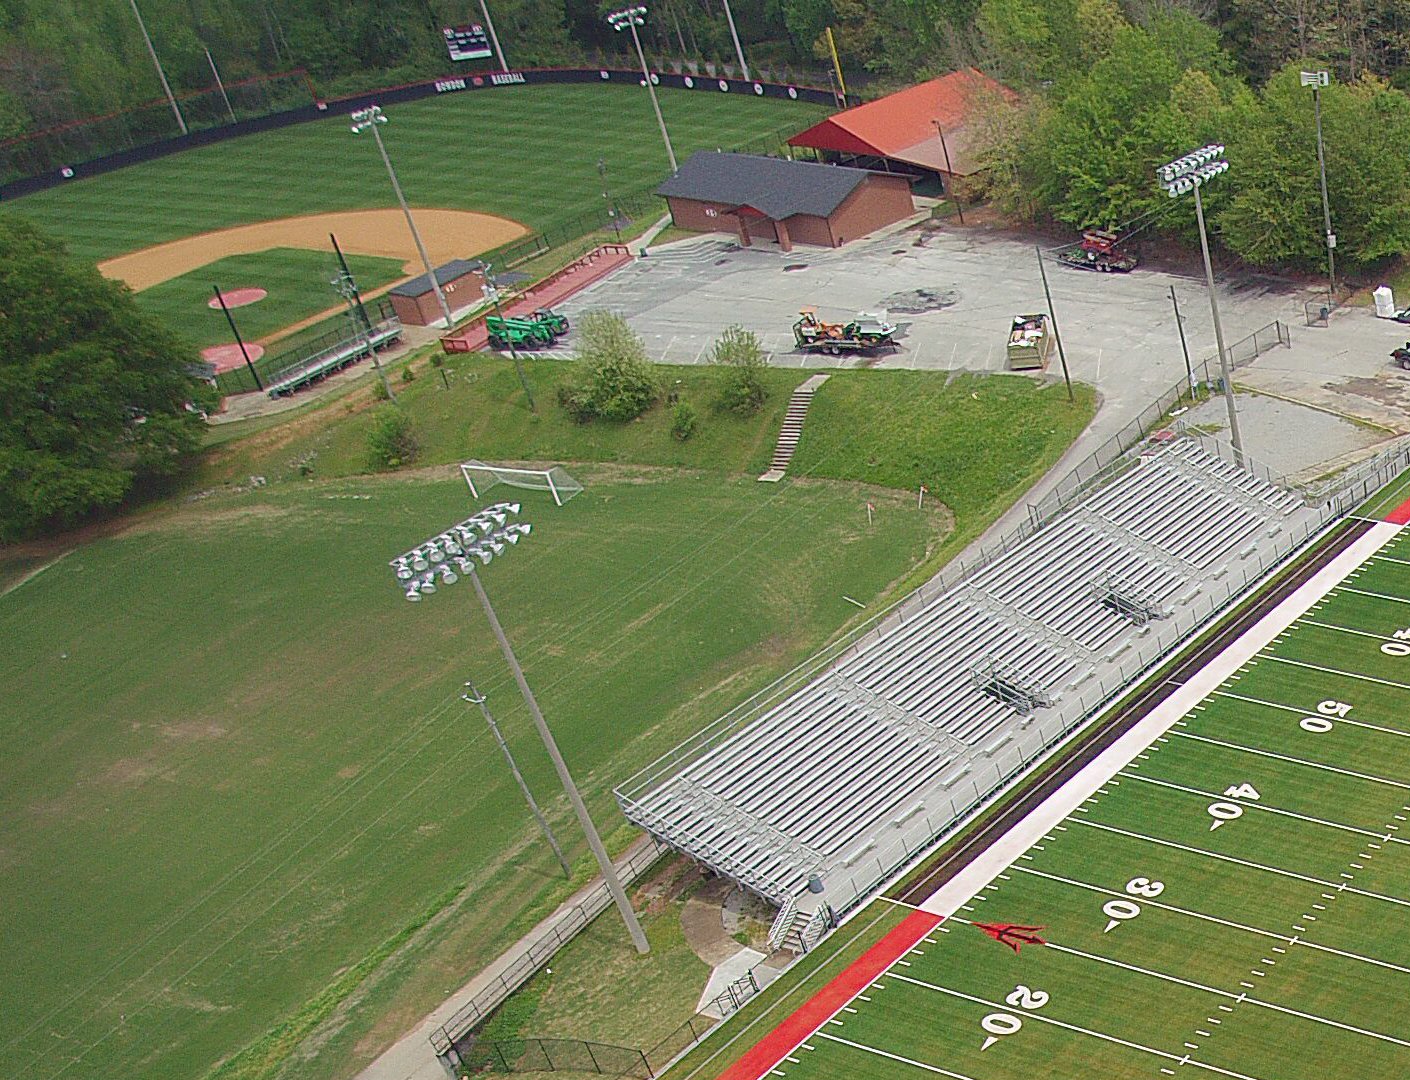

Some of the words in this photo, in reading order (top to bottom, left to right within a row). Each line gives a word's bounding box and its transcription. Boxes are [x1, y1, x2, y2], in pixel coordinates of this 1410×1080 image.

[1299, 700, 1354, 733] 50
[1207, 783, 1261, 820] 40
[1102, 877, 1165, 920] 30
[981, 985, 1050, 1035] 20
